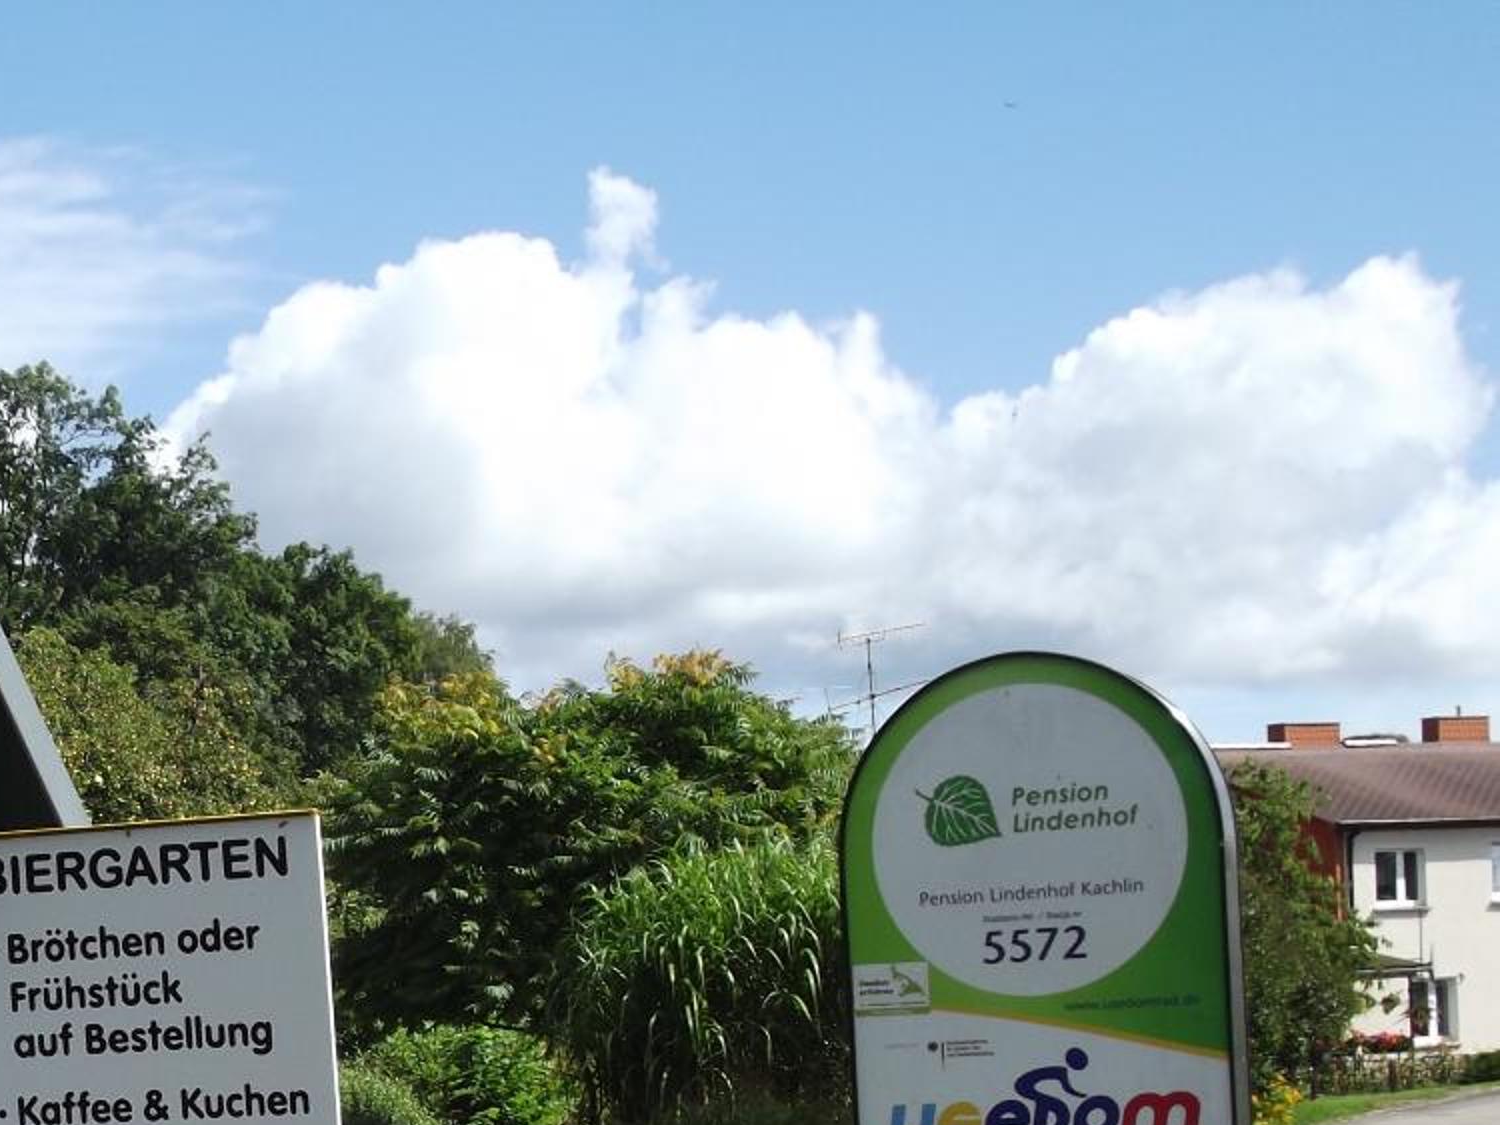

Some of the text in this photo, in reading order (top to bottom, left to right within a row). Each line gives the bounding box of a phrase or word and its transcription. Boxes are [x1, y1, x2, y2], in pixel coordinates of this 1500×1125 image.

[1012, 783, 1109, 807] Pension
[1013, 804, 1139, 834] Lindenhof
[919, 878, 1145, 907] Pension Lindenhof Kachlin
[7, 918, 260, 965] Brötchen oder
[982, 924, 1088, 966] 5572
[10, 970, 183, 1012] Frühstück
[14, 1015, 273, 1058] auf Bestellung
[143, 1089, 169, 1122] &
[181, 1084, 311, 1119] Kuchen
